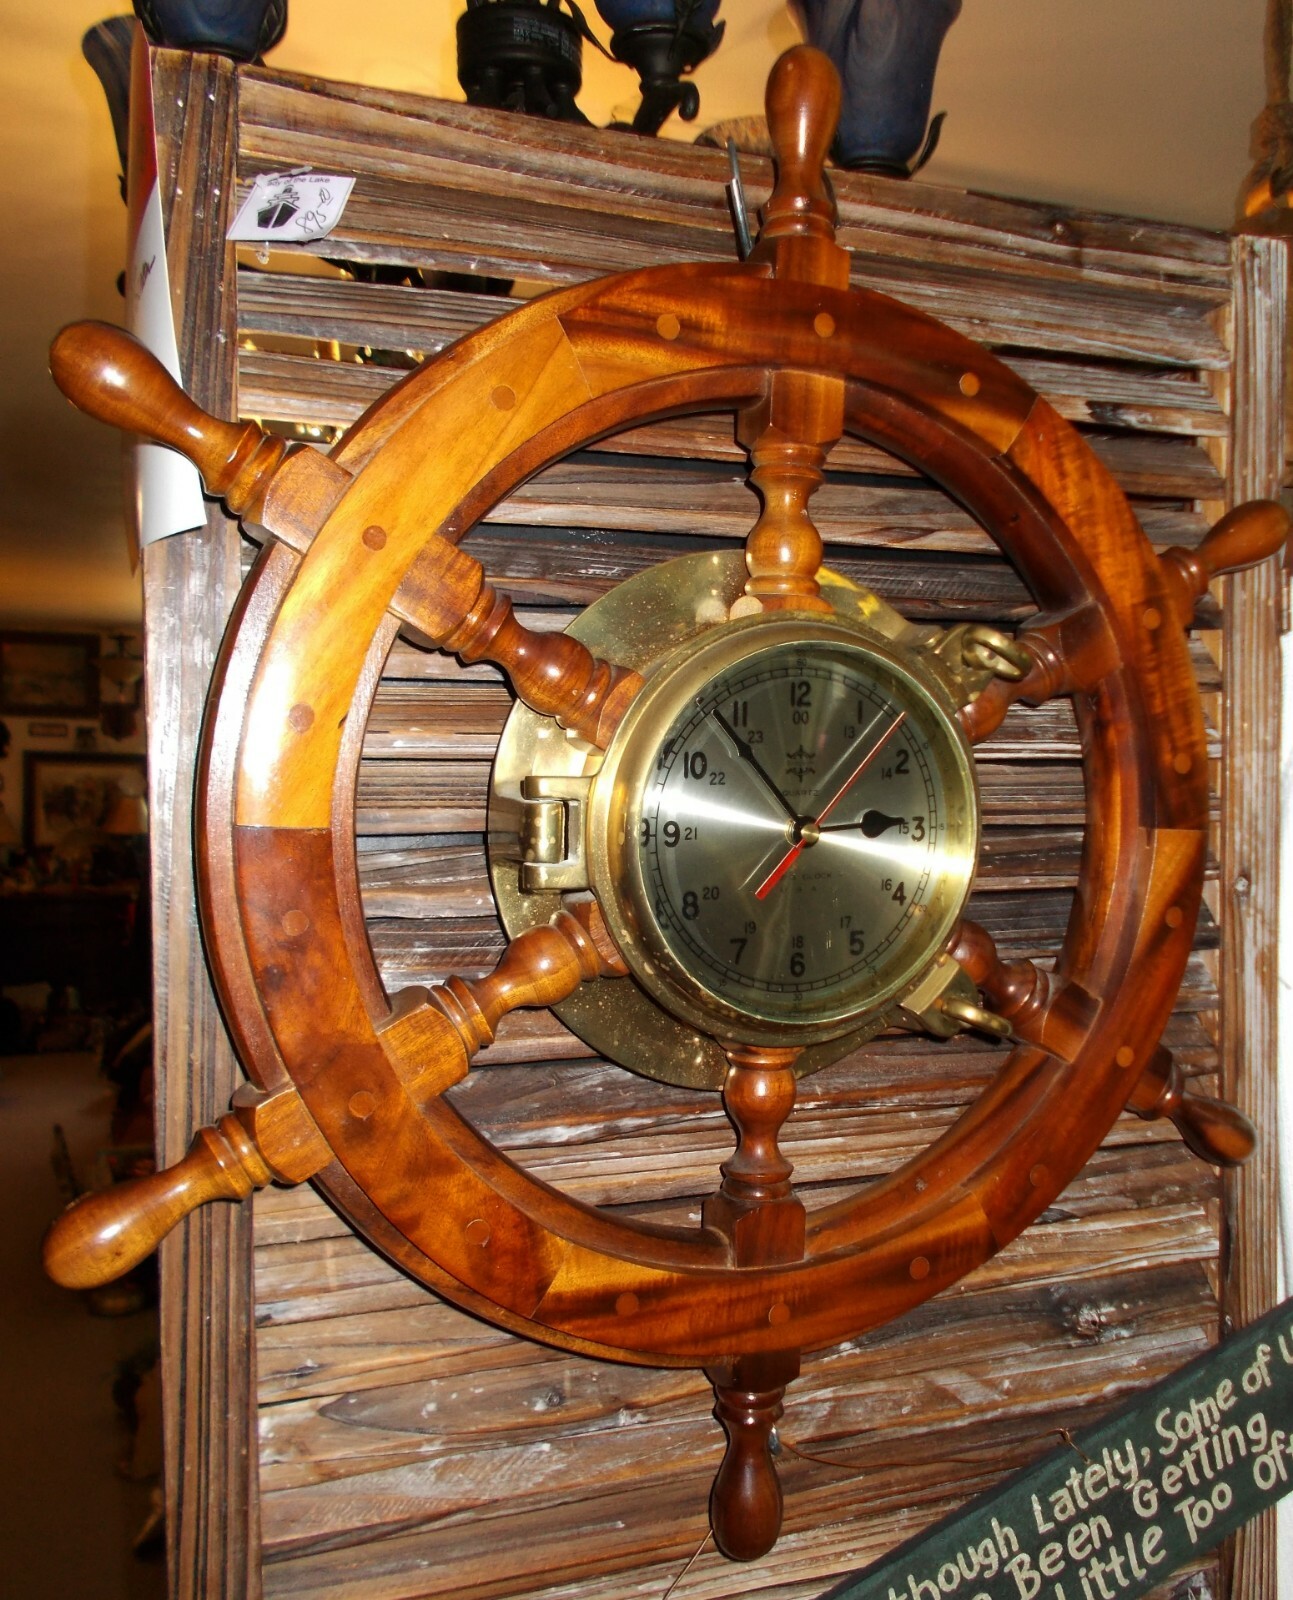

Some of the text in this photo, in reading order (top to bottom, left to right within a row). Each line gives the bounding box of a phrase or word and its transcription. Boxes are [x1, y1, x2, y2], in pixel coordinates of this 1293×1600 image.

[267, 178, 281, 187] ady
[295, 210, 327, 233] 895
[790, 681, 812, 707] 12
[733, 700, 748, 728] 11
[793, 711, 809, 724] 00
[857, 700, 863, 724] 1
[747, 730, 764, 744] 23
[844, 726, 855, 739] 13
[684, 751, 707, 780] 10
[881, 767, 892, 780] 14
[895, 749, 909, 774] 2
[709, 772, 726, 785] 22
[663, 820, 681, 848] 9
[684, 827, 698, 840] 21
[898, 821, 909, 834] 15
[911, 816, 925, 842] 3
[702, 886, 720, 900] 20
[881, 878, 892, 891] 16
[892, 882, 907, 906] 4
[682, 891, 699, 921] 8
[744, 921, 757, 934] 19
[840, 916, 851, 929] 17
[730, 938, 748, 965] 7
[792, 936, 803, 948] 18
[850, 930, 864, 956] 5
[790, 952, 805, 978] 6
[1032, 1438, 1151, 1534] Lately,
[1155, 1378, 1238, 1456] Some
[1242, 1343, 1272, 1394] of
[1004, 1412, 1268, 1600] Been Getting
[1174, 1482, 1233, 1544] Too
